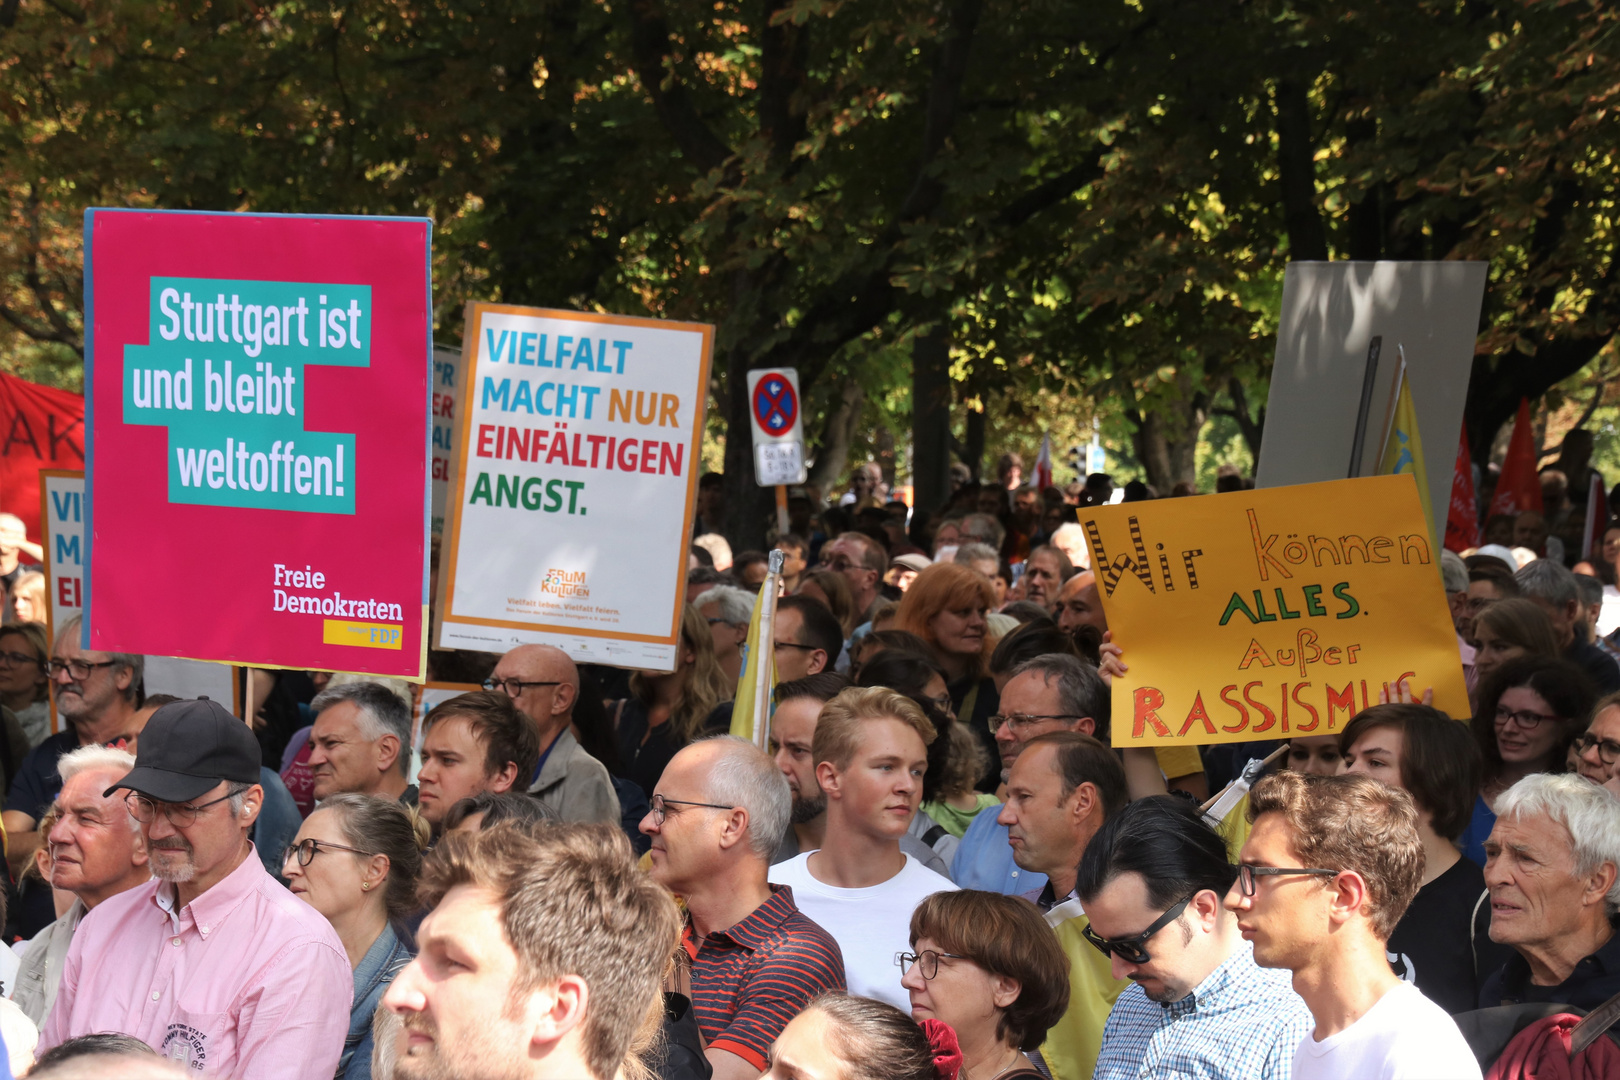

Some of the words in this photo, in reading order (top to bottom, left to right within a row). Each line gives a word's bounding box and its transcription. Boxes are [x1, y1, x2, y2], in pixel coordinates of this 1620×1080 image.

[159, 287, 309, 358] Stuttgart
[319, 294, 362, 349] ist
[486, 328, 633, 375] VIELFALT
[132, 358, 193, 411] und
[204, 358, 296, 416] bleibt
[481, 376, 601, 420] MACHT
[607, 388, 680, 428] NUR
[176, 437, 345, 497] weltoffen!
[476, 421, 684, 477] EINFÄLTIGEN
[469, 472, 587, 516] ANGST.
[1084, 515, 1204, 598] Wir
[1246, 508, 1431, 581] können
[273, 563, 326, 589] Freie
[273, 589, 403, 621] Demokraten
[507, 597, 536, 607] Vielfalt
[564, 603, 593, 613] Vielfalt
[1218, 582, 1369, 626] ALLES.
[369, 628, 400, 644] FDP
[1237, 628, 1361, 677] Außer
[179, 1030, 206, 1060] HILFIGER
[188, 1027, 207, 1040] STATE
[191, 1060, 205, 1071] 85
